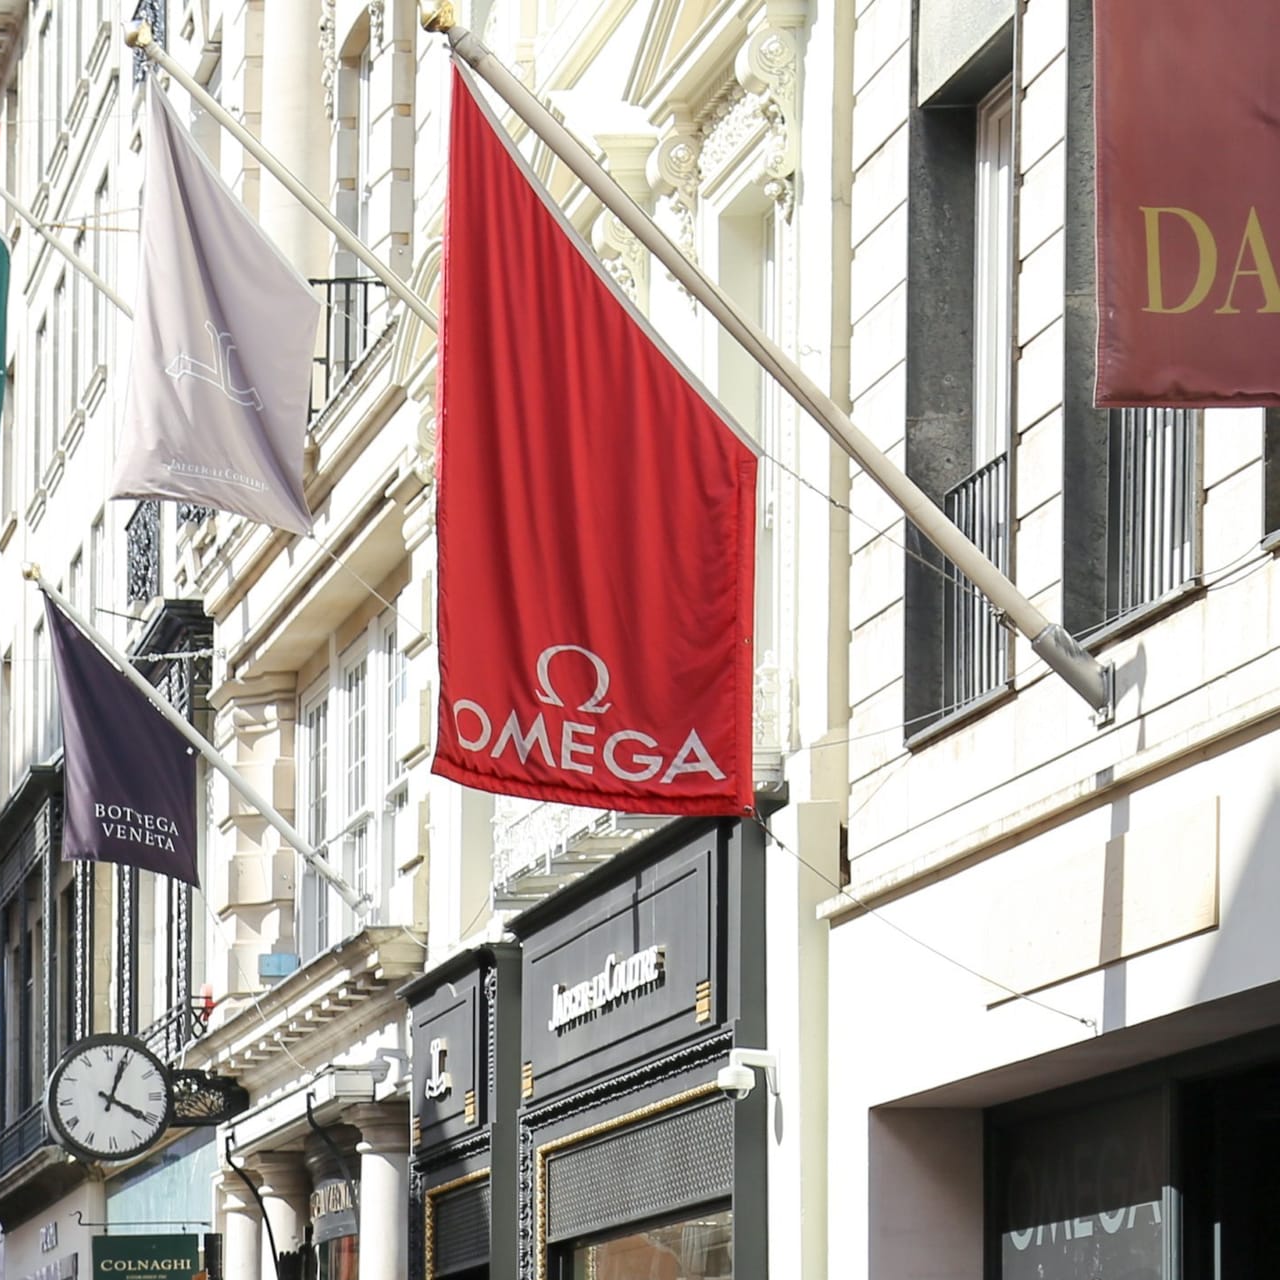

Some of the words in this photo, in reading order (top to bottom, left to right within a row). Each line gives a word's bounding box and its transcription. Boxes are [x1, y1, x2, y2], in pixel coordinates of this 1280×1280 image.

[452, 698, 727, 785] OMEGA
[95, 802, 179, 837] BOTTEGA
[102, 822, 176, 853] VENETA
[100, 1259, 193, 1272] COLNAGHI
